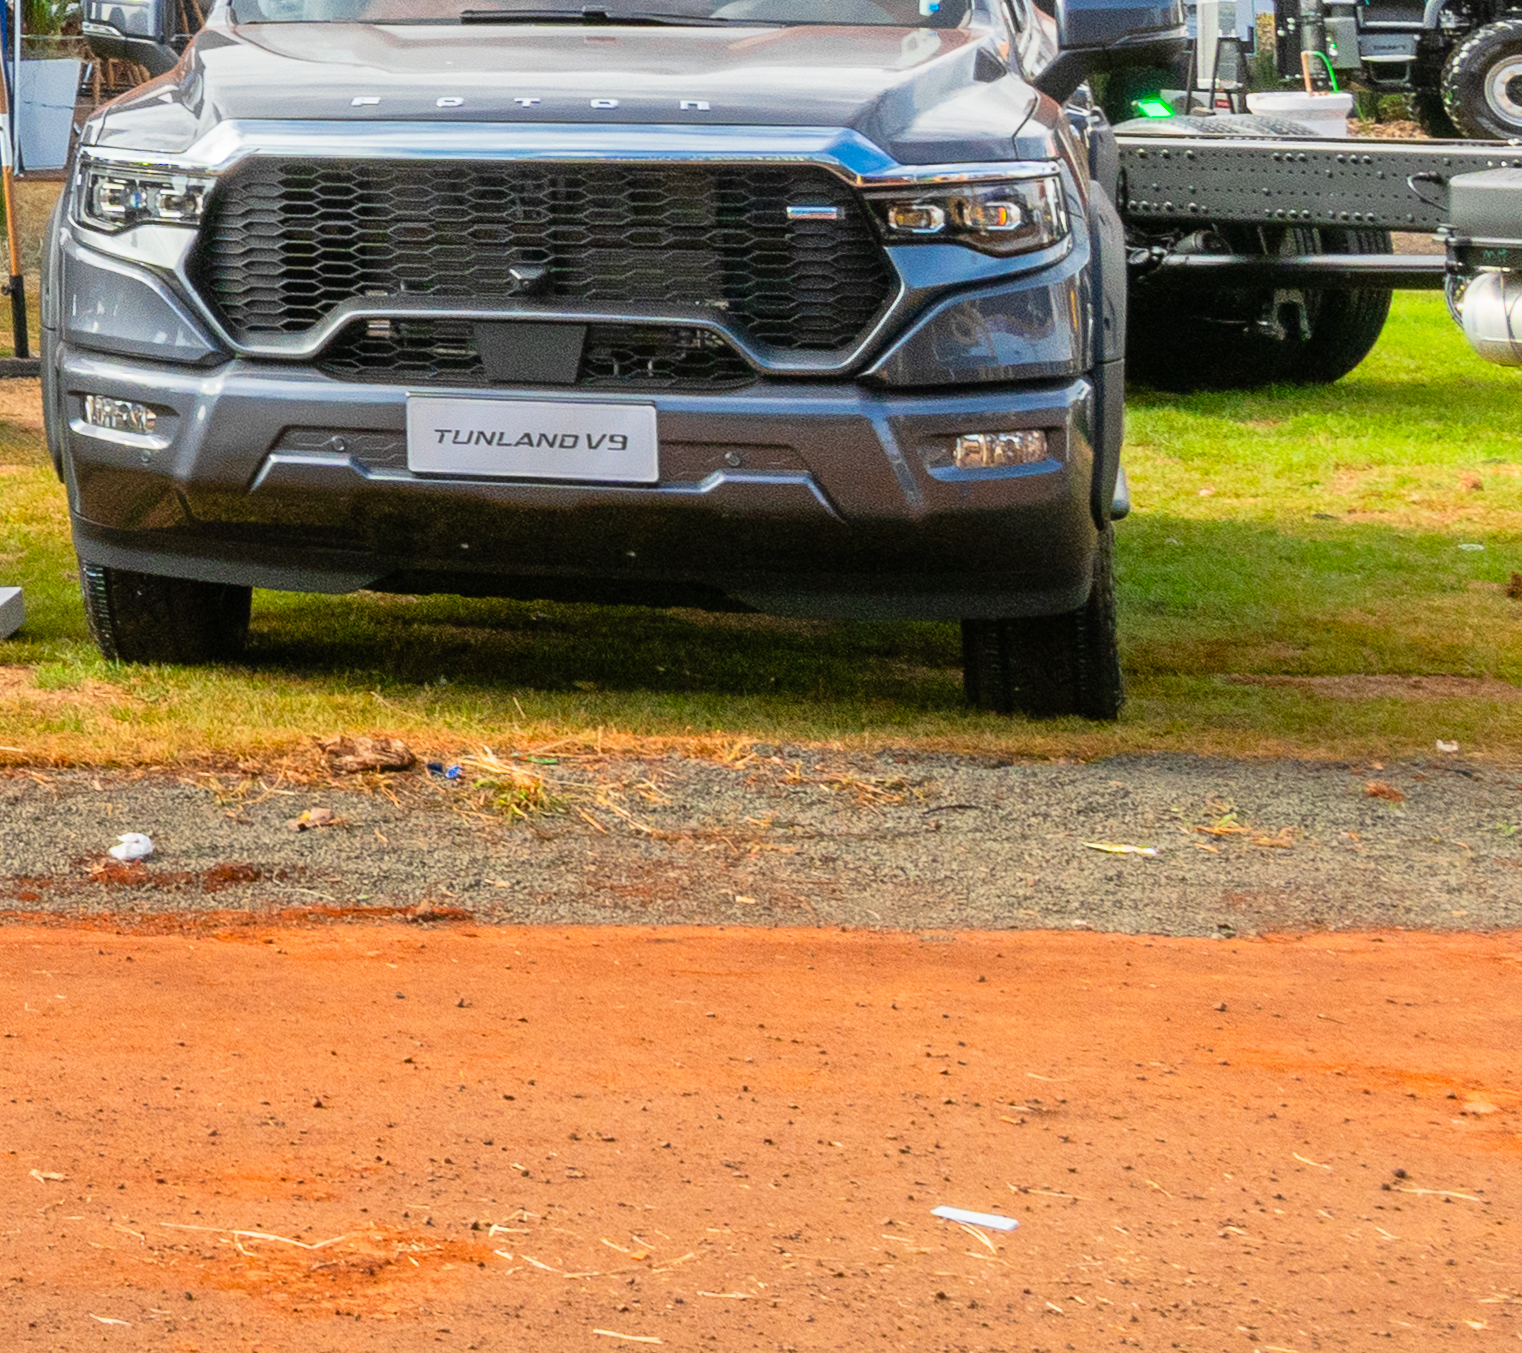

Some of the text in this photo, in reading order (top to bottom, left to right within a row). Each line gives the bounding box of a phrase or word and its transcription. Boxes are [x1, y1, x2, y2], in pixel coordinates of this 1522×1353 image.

[350, 96, 711, 111] FOTON
[434, 428, 629, 451] TUNLAND V9
